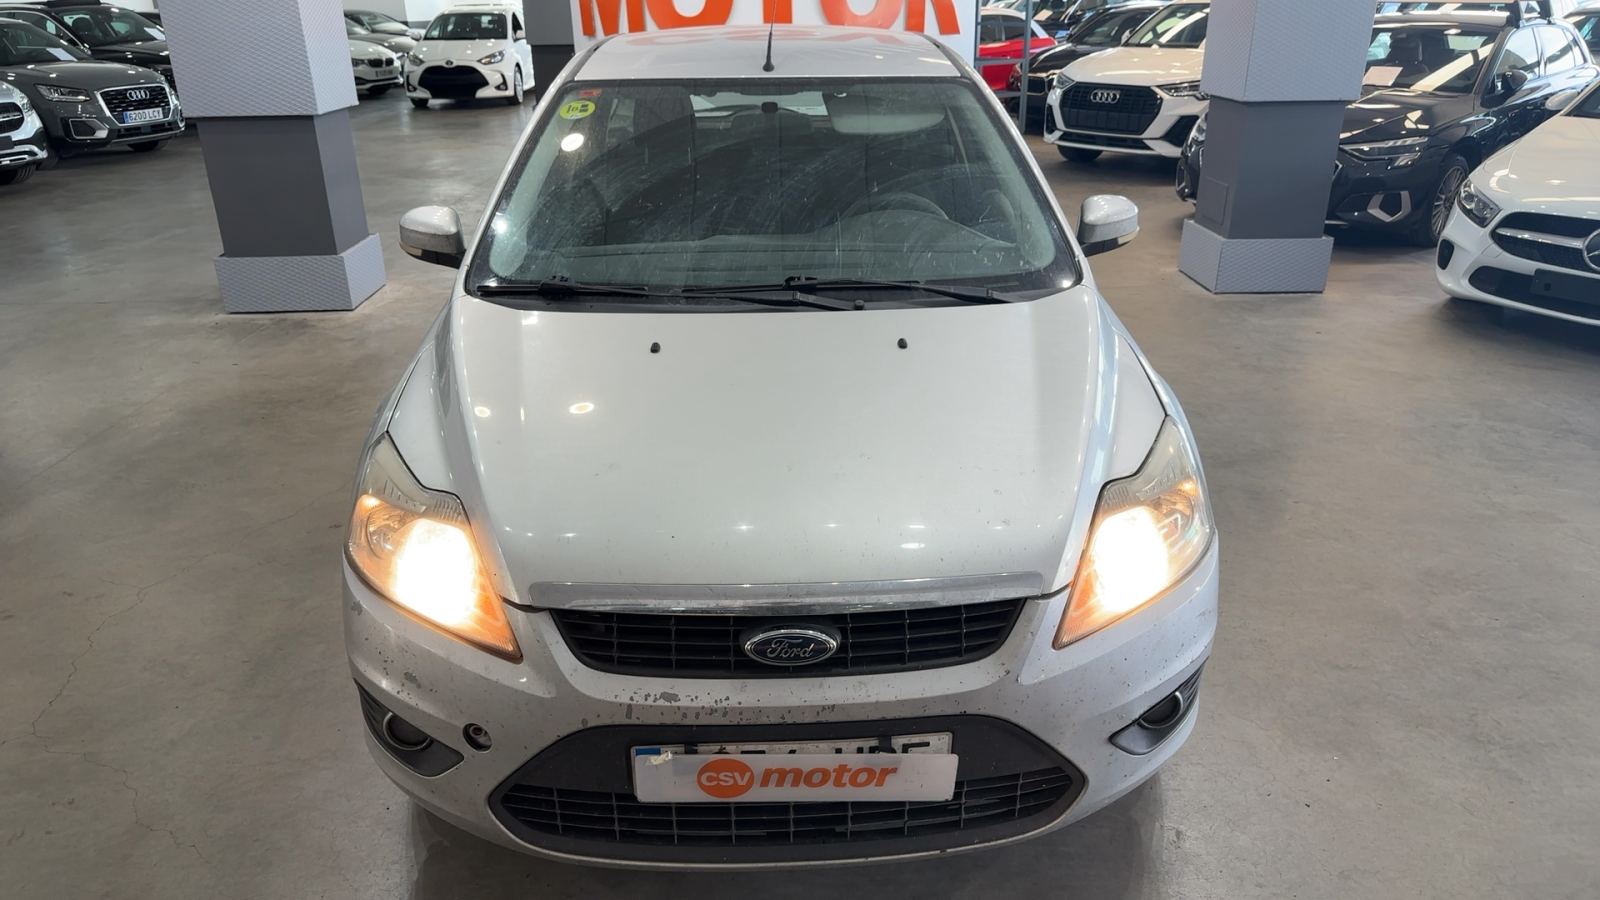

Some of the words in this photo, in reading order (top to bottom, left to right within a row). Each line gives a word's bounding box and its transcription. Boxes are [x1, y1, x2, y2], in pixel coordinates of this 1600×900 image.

[129, 111, 147, 121] 6200
[766, 638, 814, 658] Ford
[761, 765, 898, 788] motor
